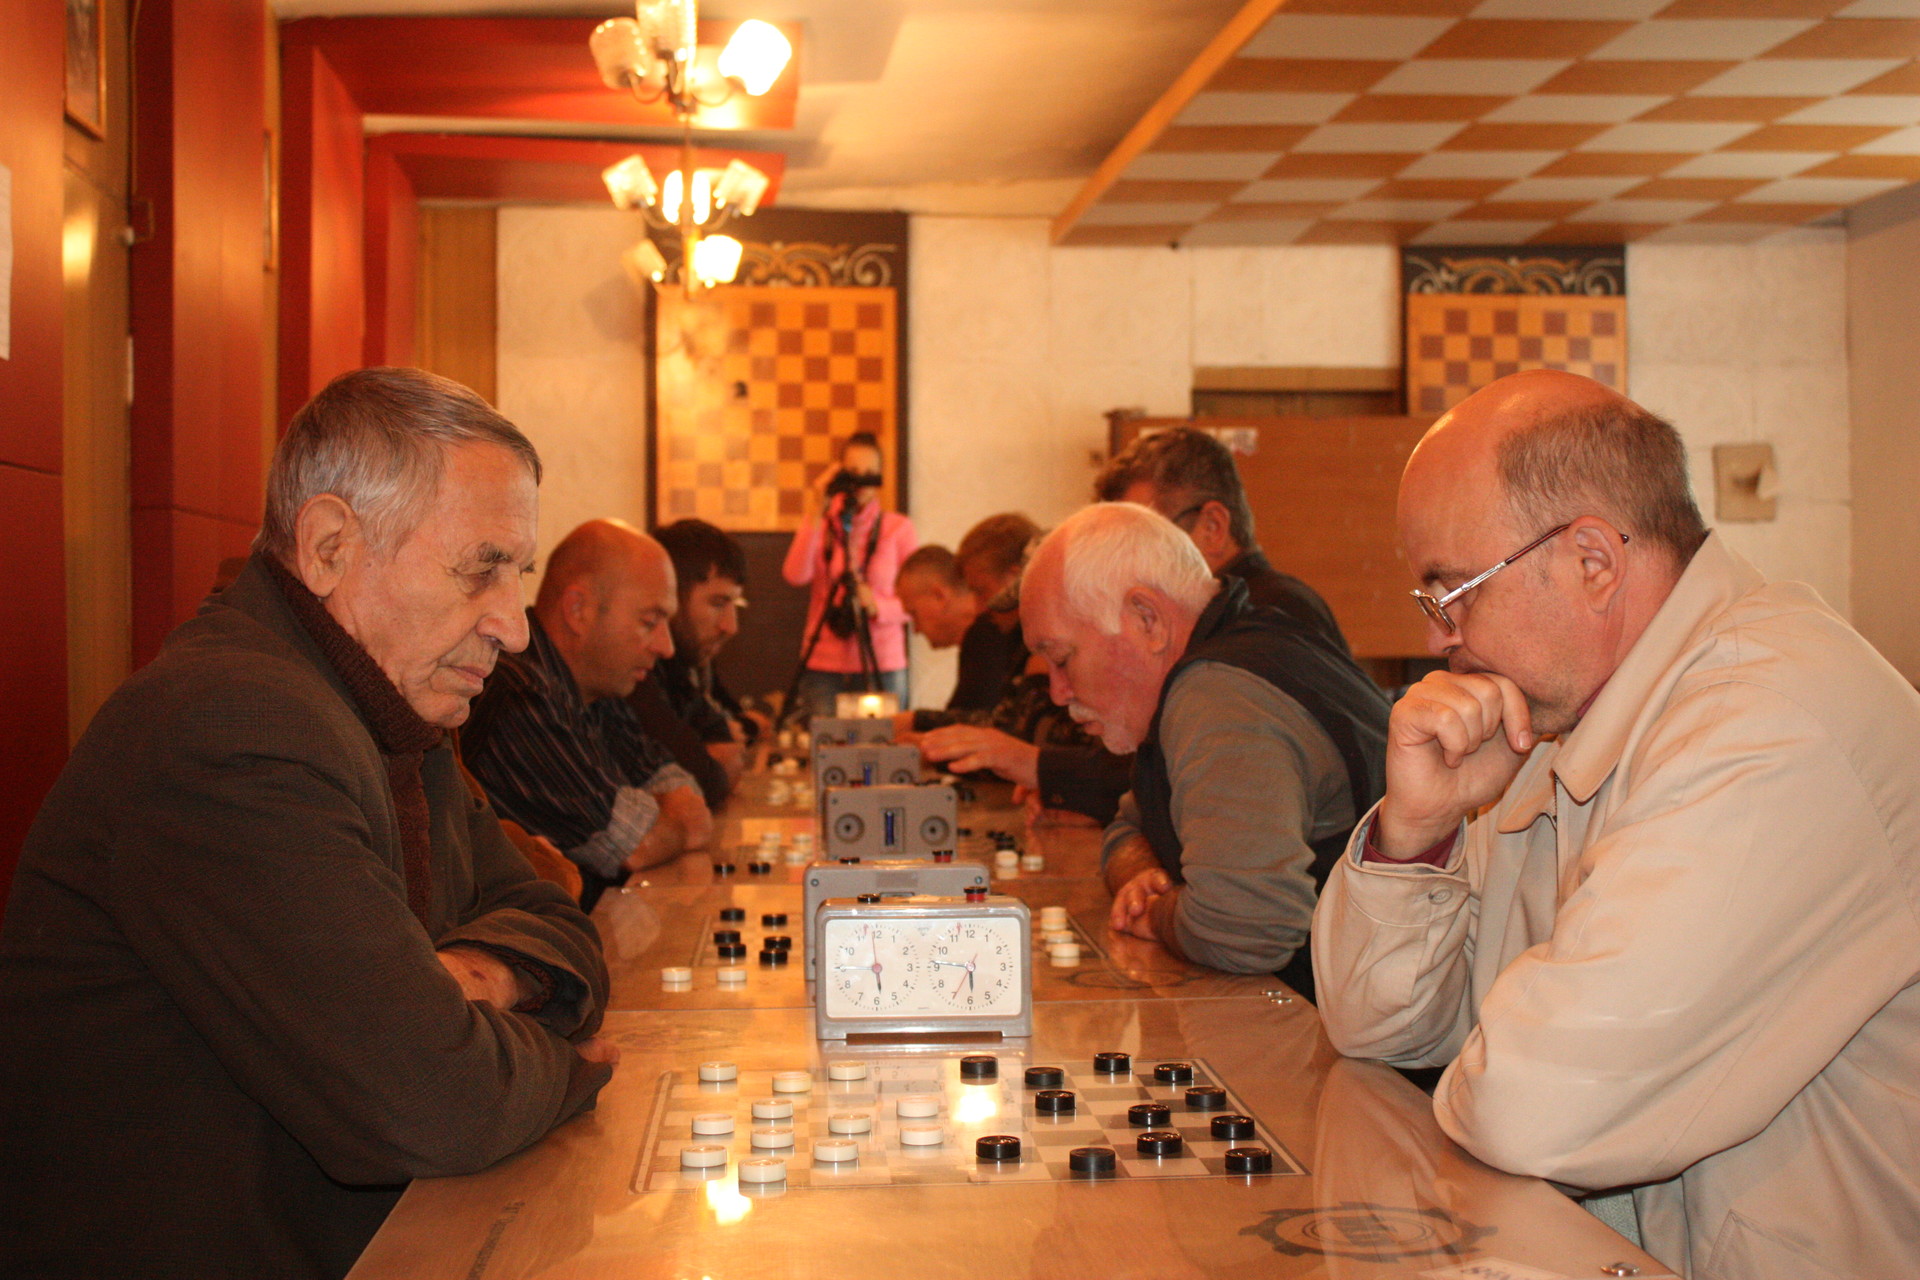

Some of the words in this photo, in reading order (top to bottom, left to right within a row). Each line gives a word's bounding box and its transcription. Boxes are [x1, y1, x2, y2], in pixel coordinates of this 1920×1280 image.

[950, 934, 959, 942] 11
[965, 929, 976, 939] 12
[845, 946, 855, 956] 10
[902, 946, 909, 955] 2
[938, 946, 948, 955] 10
[996, 946, 1002, 955] 2
[907, 963, 913, 972] 3
[933, 963, 940, 972] 9
[1000, 962, 1006, 971] 3
[845, 980, 851, 989] 8
[902, 980, 909, 988] 4
[938, 979, 944, 988] 8
[996, 979, 1002, 987] 4
[858, 992, 864, 1000] 7
[891, 991, 898, 1001] 5
[951, 991, 957, 1000] 7
[984, 991, 991, 1000] 5
[874, 996, 880, 1006] 6
[967, 996, 974, 1005] 6
